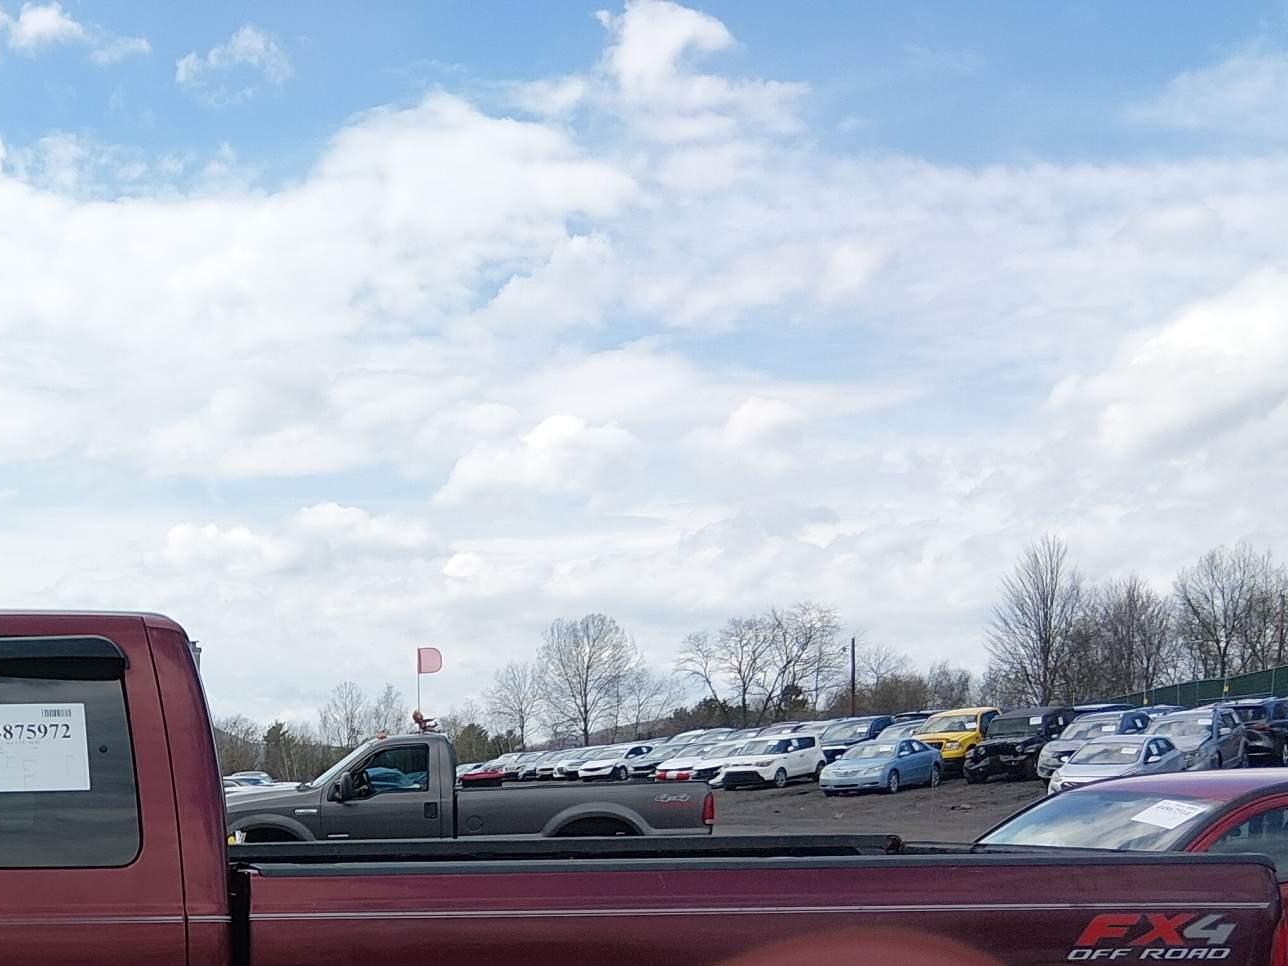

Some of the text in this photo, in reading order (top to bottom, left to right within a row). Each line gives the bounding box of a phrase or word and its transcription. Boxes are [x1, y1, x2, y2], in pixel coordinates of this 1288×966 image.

[1074, 912, 1239, 946] FX4
[1067, 949, 1231, 960] OFF ROAD
